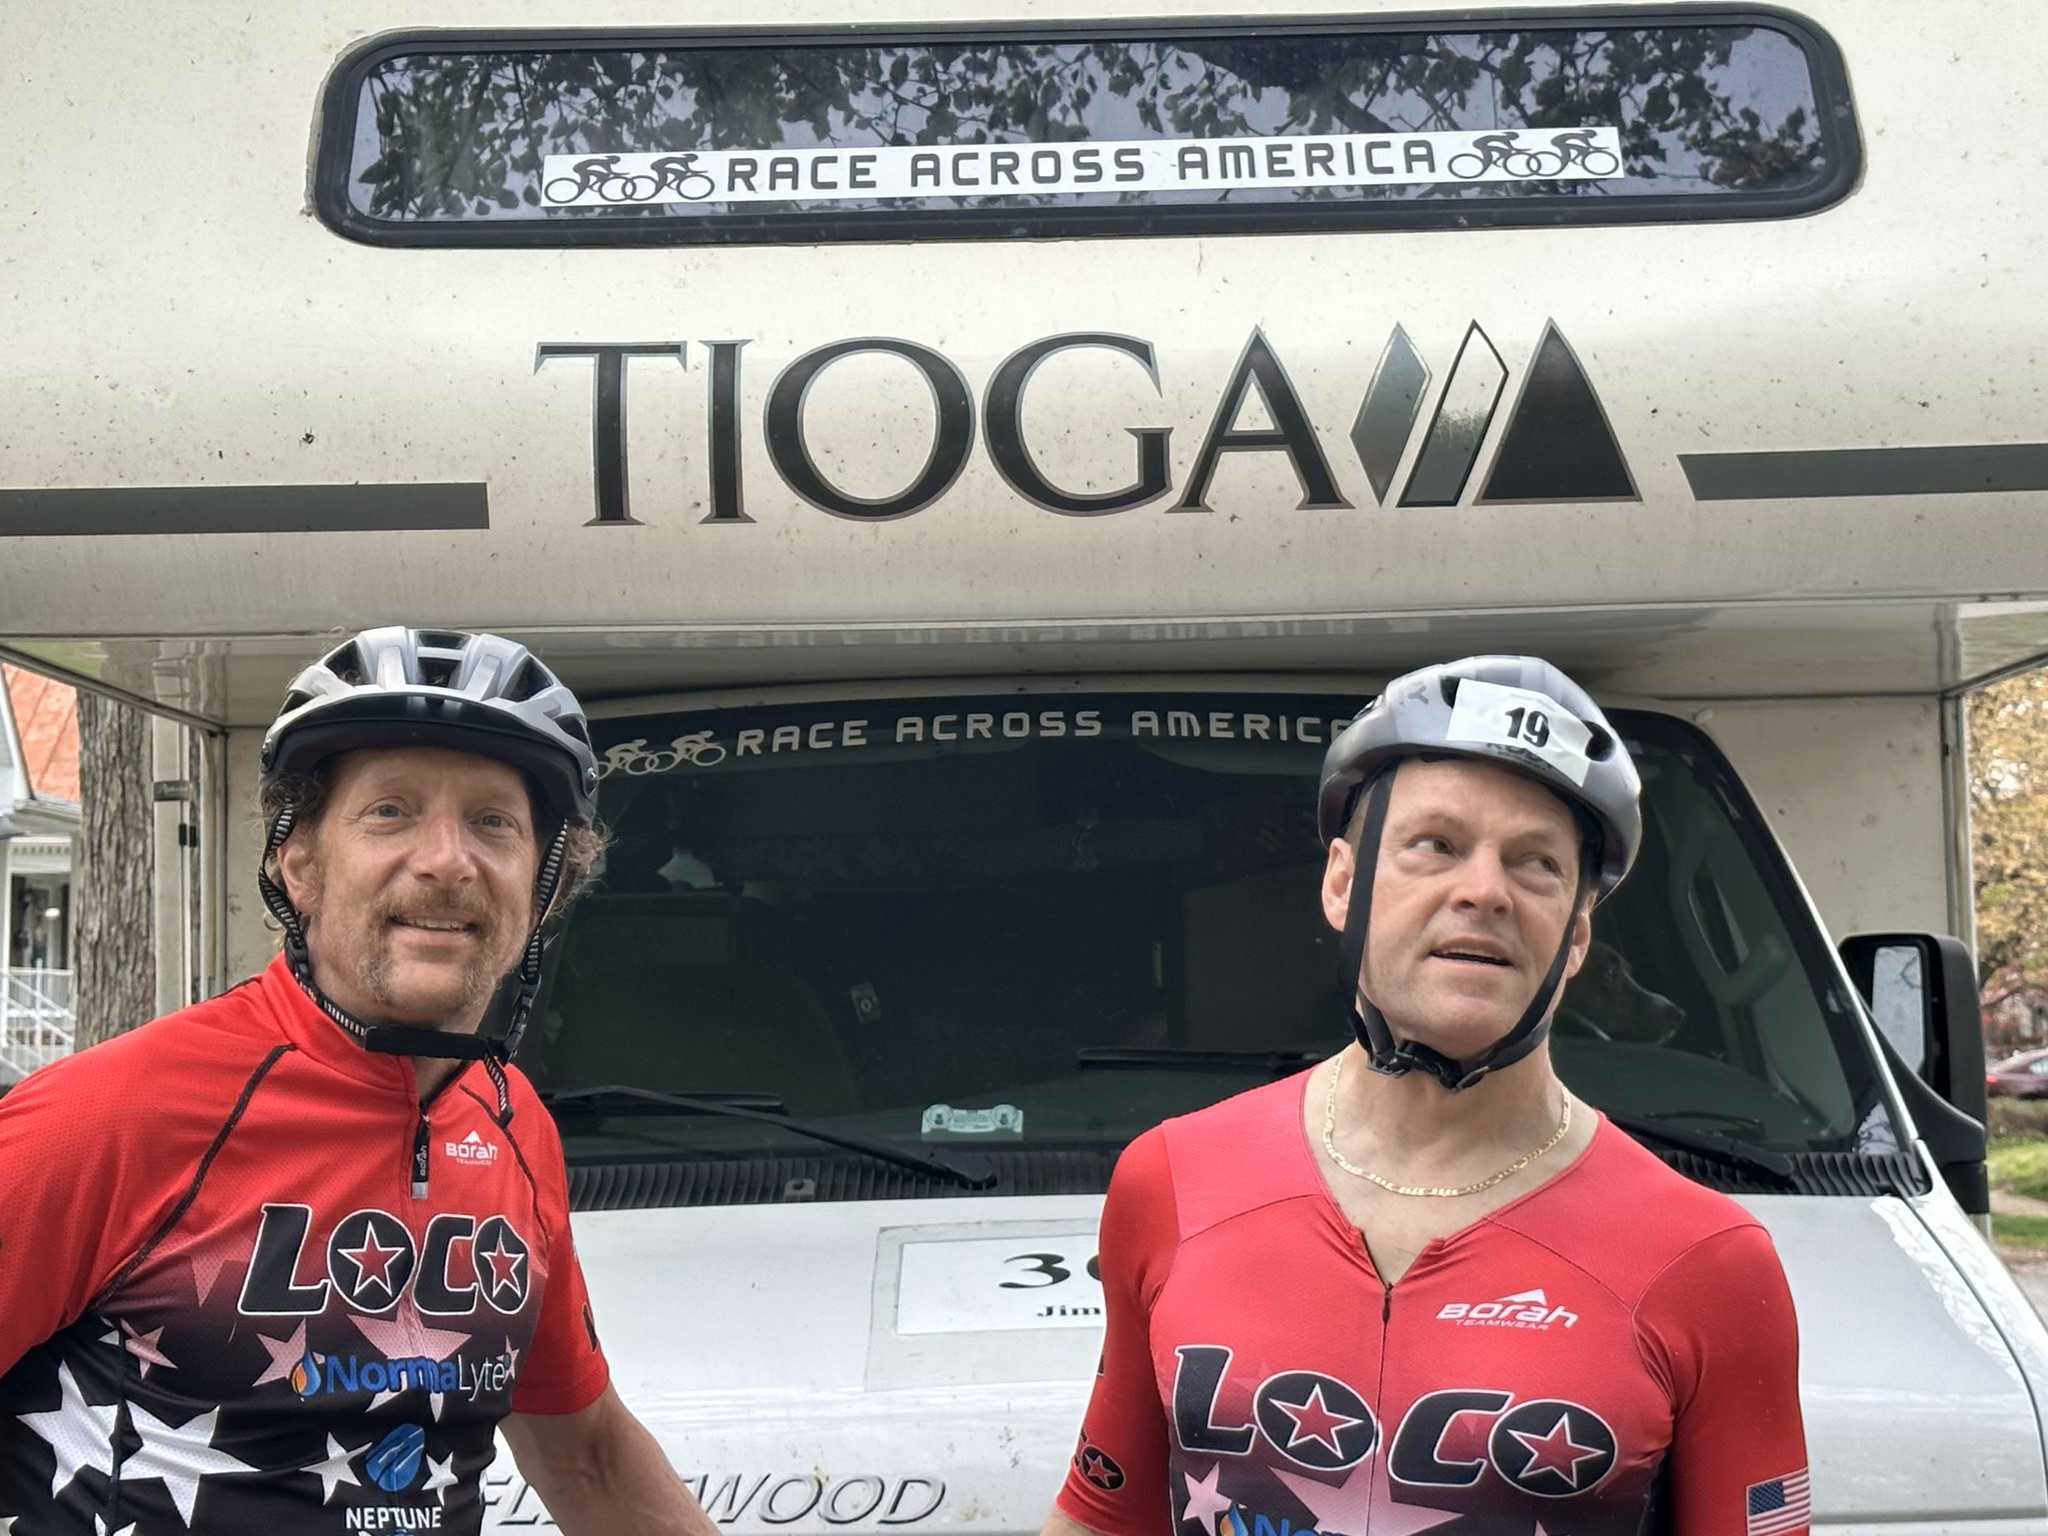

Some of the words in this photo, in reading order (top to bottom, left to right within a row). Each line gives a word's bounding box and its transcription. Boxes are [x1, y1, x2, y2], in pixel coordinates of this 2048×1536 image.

[727, 154, 877, 193] RACE
[910, 147, 1145, 188] ACROSS
[1178, 140, 1436, 181] AMERICA
[533, 324, 1356, 527] TIOGA
[736, 718, 868, 757] RACE
[895, 710, 1103, 743] ACROSS
[1504, 706, 1550, 748] 19
[237, 1203, 530, 1315] LOCO
[1037, 1305, 1101, 1317] Jim
[326, 1354, 506, 1402] NormaLyte
[1174, 1345, 1618, 1498] LOCO
[346, 1507, 442, 1529] NEPTUNE
